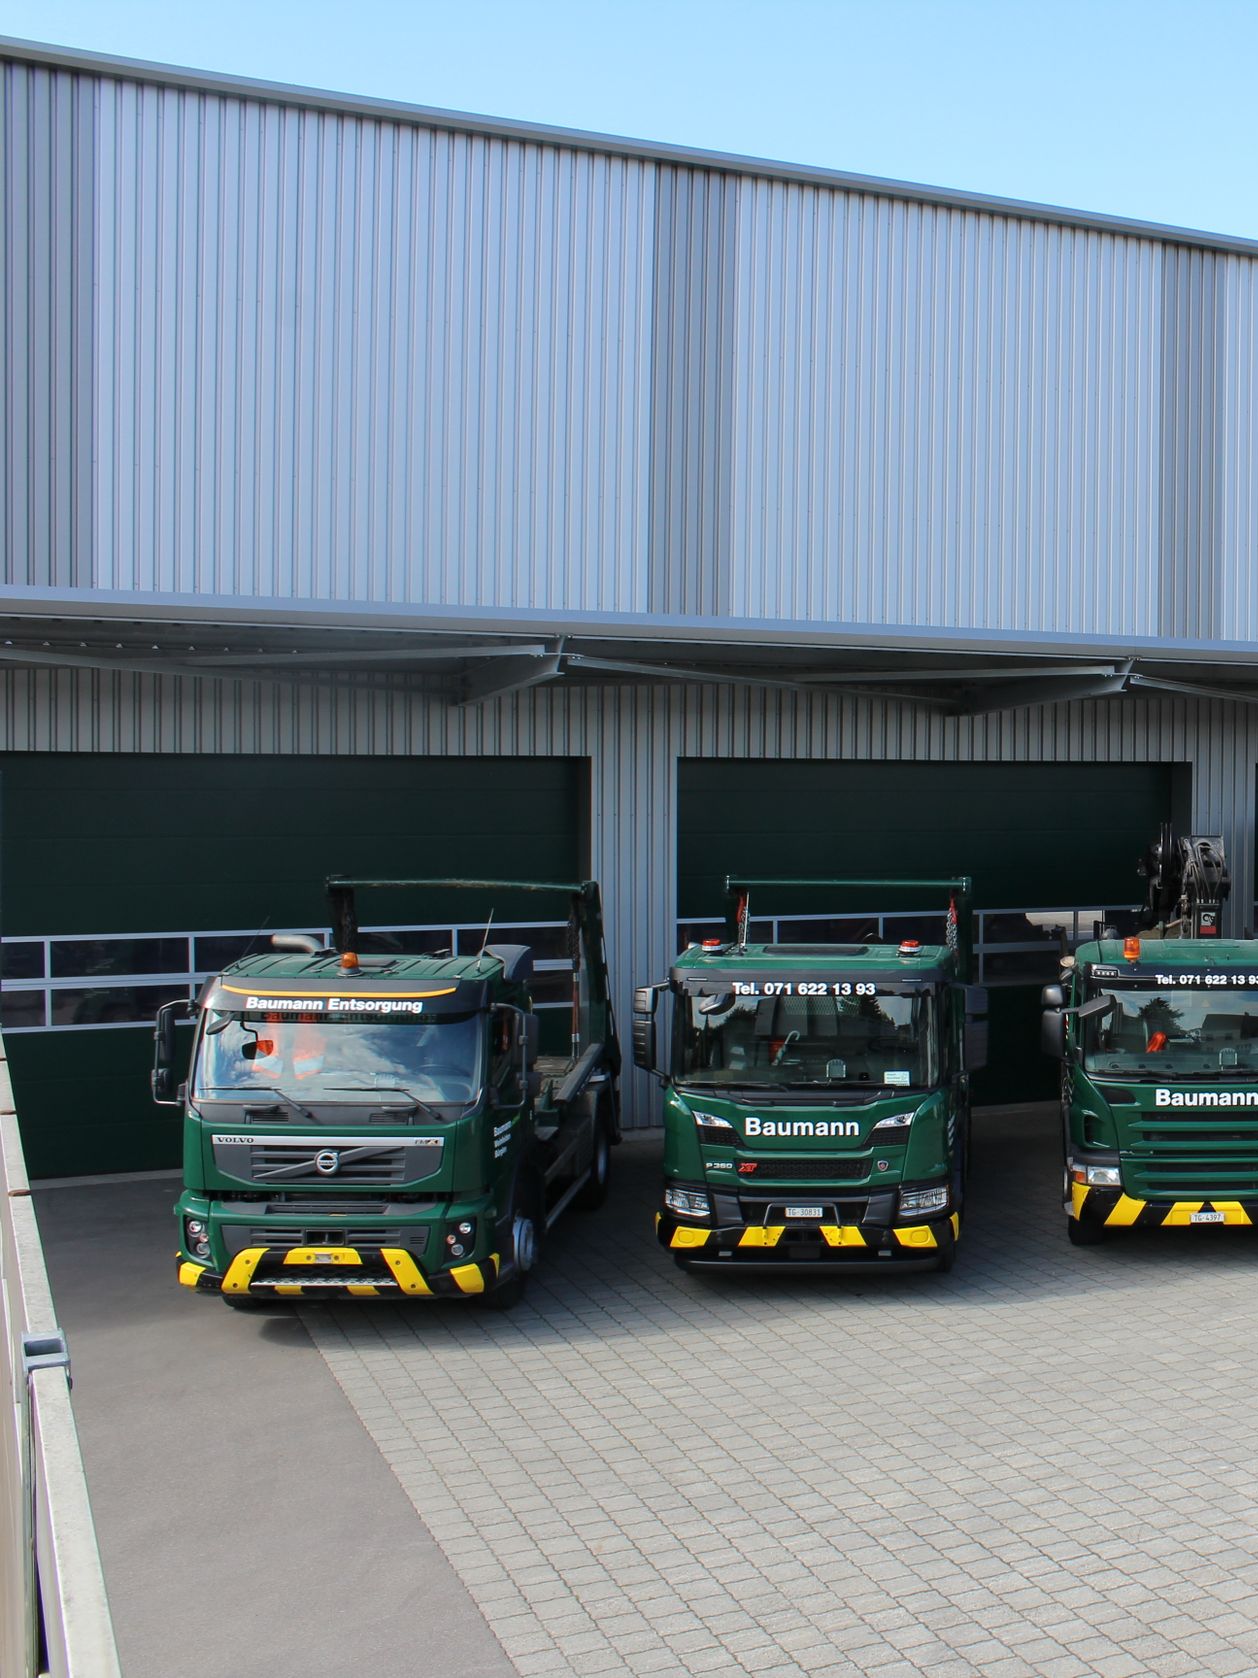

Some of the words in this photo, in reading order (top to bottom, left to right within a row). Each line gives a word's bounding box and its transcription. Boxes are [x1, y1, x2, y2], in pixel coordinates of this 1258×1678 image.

[1155, 975, 1176, 985] Tel.
[1179, 975, 1201, 985] 071
[1205, 975, 1227, 985] 622
[1231, 975, 1246, 985] 13
[732, 982, 760, 996] Tel.
[763, 982, 792, 996] 071
[797, 982, 828, 996] 622
[832, 982, 852, 996] 13
[855, 982, 876, 996] 93
[246, 996, 323, 1010] Baumann
[327, 998, 423, 1013] Entsorgung
[1155, 1089, 1258, 1106] Baumann
[745, 1117, 860, 1136] Baumann
